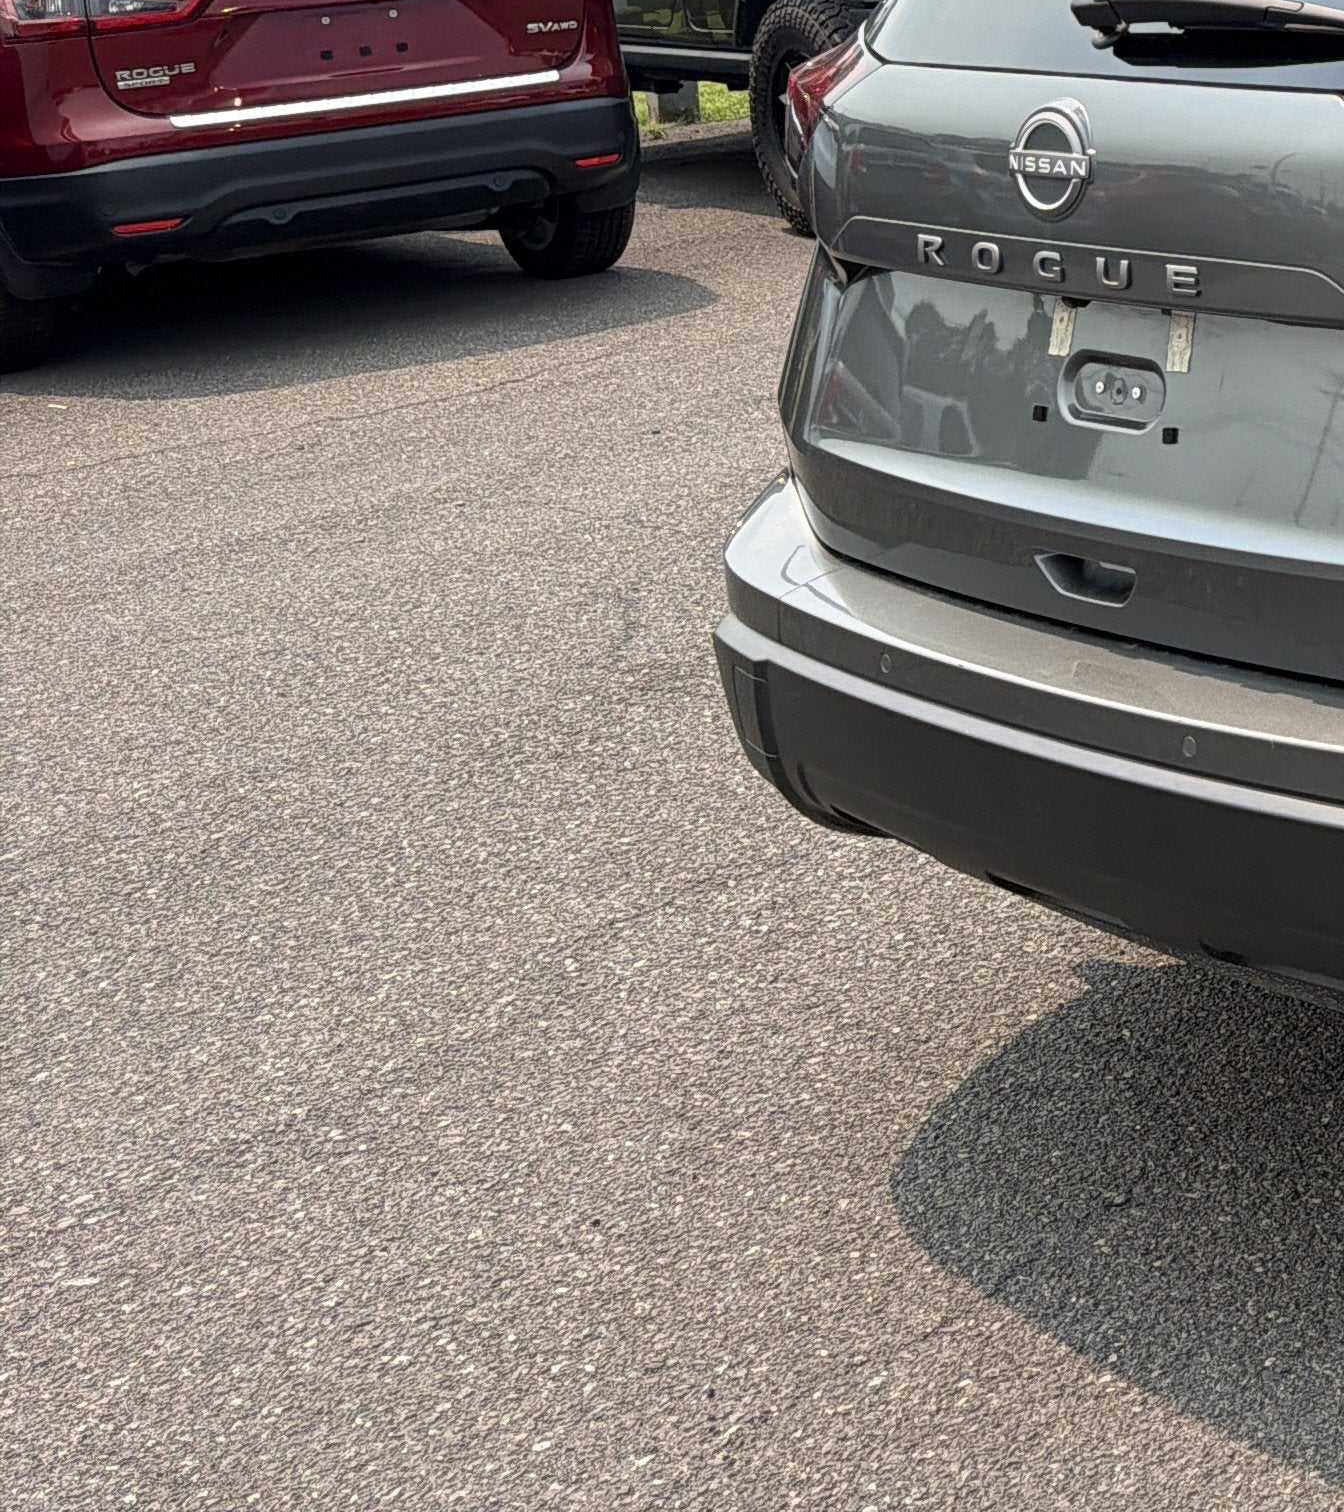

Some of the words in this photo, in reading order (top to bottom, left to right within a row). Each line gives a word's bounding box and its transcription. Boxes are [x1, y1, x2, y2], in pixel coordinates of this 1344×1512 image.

[526, 21, 554, 34] SV
[552, 20, 578, 31] AWD
[115, 63, 196, 81] ROGUE
[1009, 154, 1087, 177] NISSAN
[917, 233, 1201, 297] ROGUE
